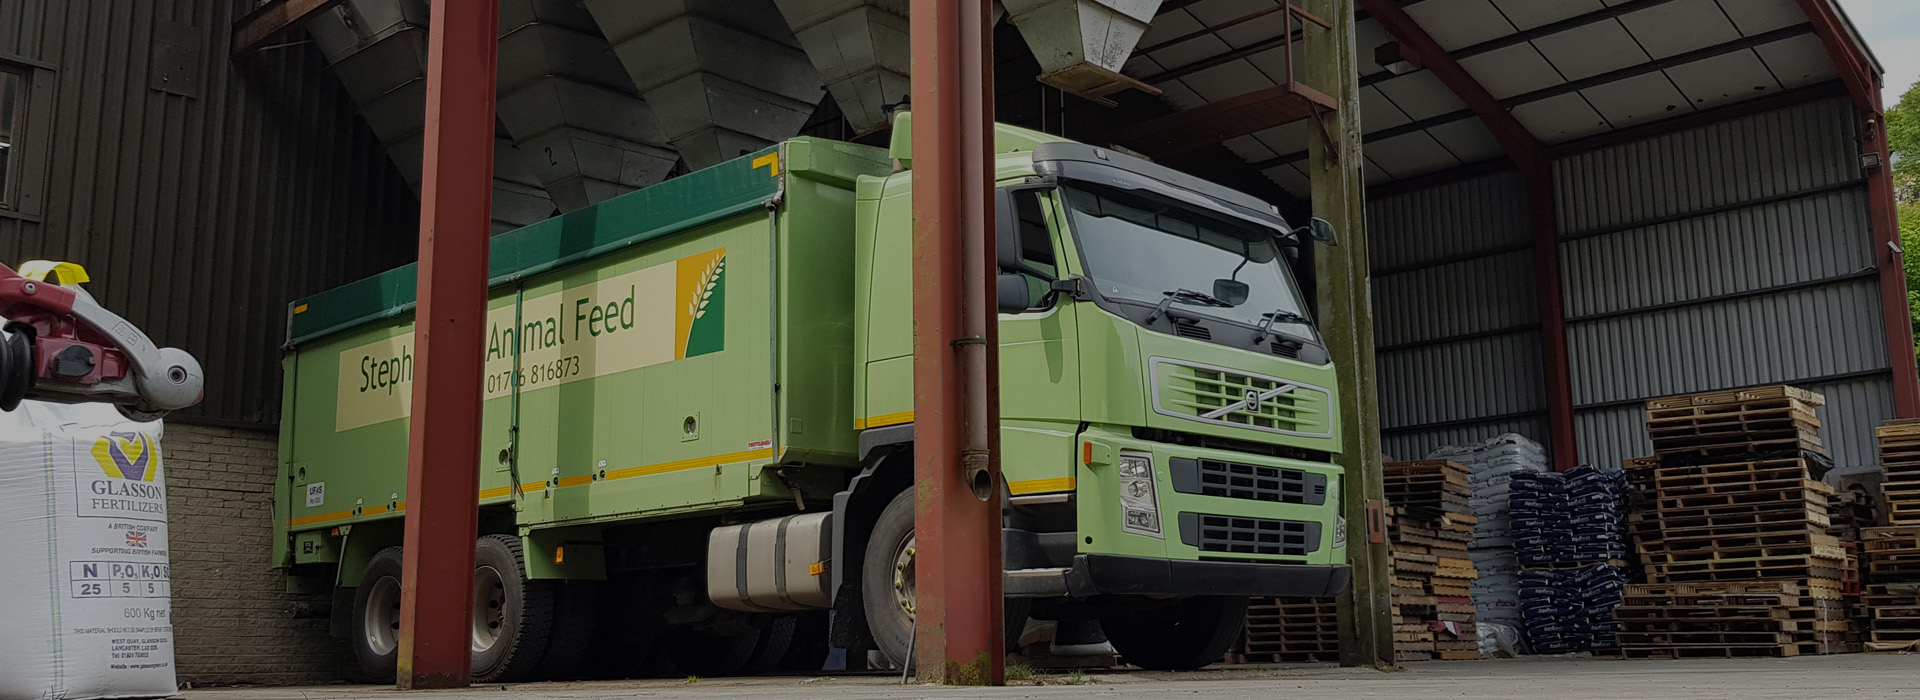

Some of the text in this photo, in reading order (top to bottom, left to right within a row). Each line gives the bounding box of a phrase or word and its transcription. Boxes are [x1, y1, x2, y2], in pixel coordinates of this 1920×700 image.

[544, 146, 557, 166] 2
[360, 345, 412, 395] Steph
[575, 284, 635, 340] Feed
[531, 355, 579, 385] 816873
[91, 480, 162, 500] GLASSON
[91, 498, 164, 514] FERTILIZERS
[113, 523, 136, 531] BRITISH
[91, 547, 131, 555] SUPPORTING
[132, 548, 151, 556] BRITISH
[83, 563, 98, 578] N
[81, 583, 102, 596] 25
[122, 582, 131, 594] 5
[148, 582, 155, 594] 5
[124, 607, 142, 619] 600
[143, 607, 155, 621] Kg
[156, 609, 166, 618] net
